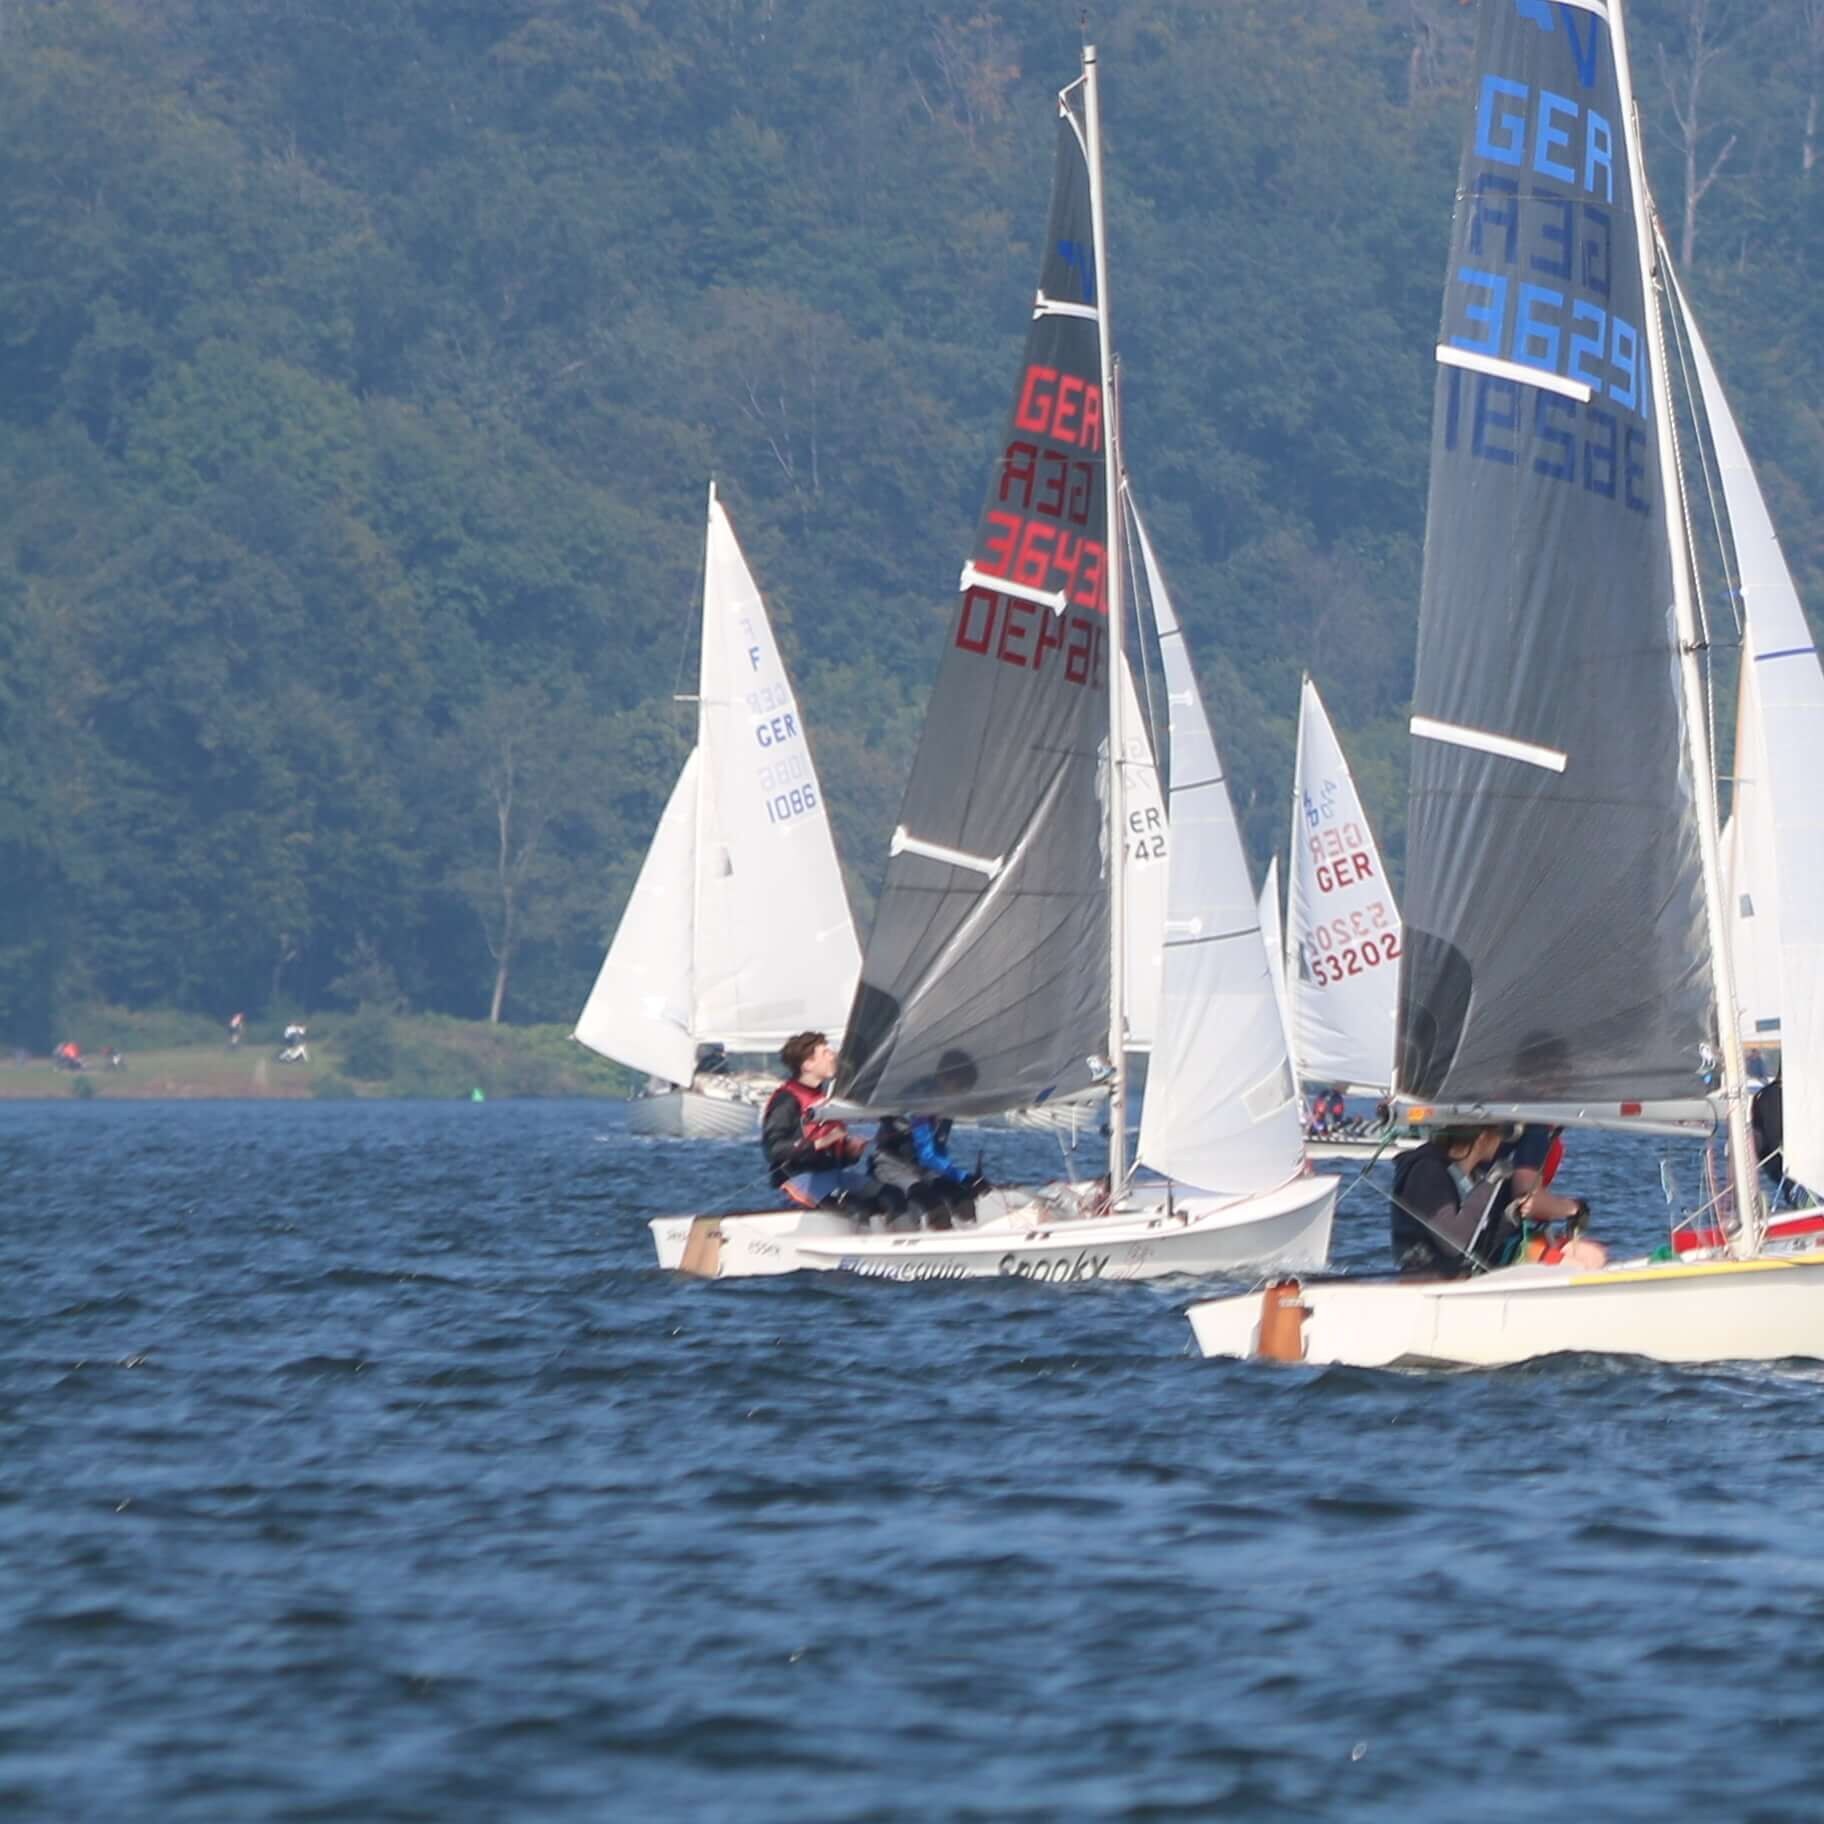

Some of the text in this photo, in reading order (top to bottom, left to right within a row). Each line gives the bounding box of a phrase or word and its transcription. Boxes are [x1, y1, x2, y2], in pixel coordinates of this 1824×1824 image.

[1473, 75, 1613, 204] GER
[1448, 267, 1648, 419] 36291
[1015, 364, 1101, 452] GER
[748, 646, 760, 672] F
[756, 713, 797, 748] GER
[767, 783, 817, 824] 1086
[1316, 851, 1374, 894] GER
[1311, 933, 1402, 987] 53202
